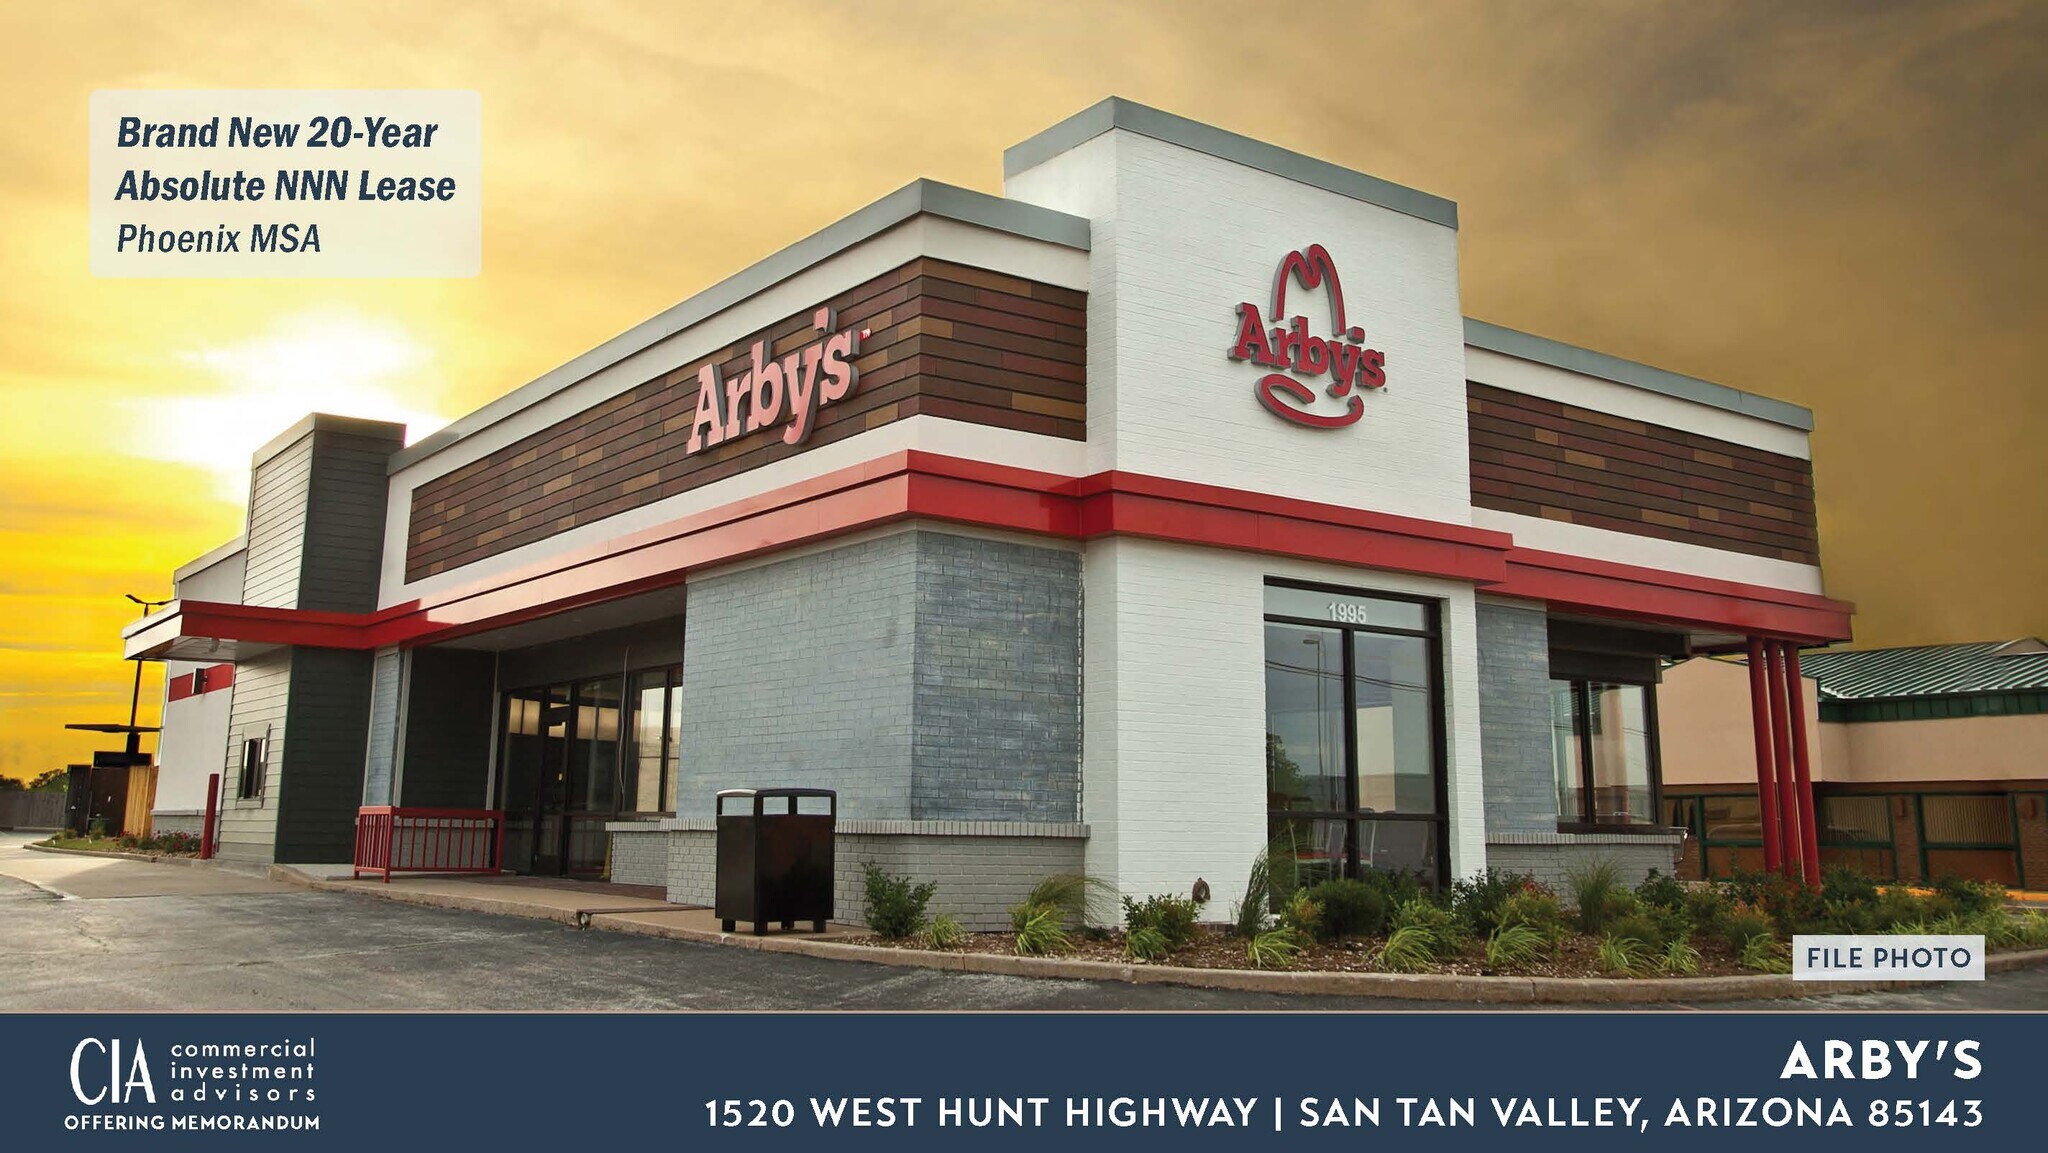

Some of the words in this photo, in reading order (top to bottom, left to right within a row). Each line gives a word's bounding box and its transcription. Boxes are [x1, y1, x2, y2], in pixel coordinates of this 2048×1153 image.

[686, 306, 859, 455] Arby's
[1227, 302, 1386, 398] Arby's
[1328, 602, 1367, 624] 1995
